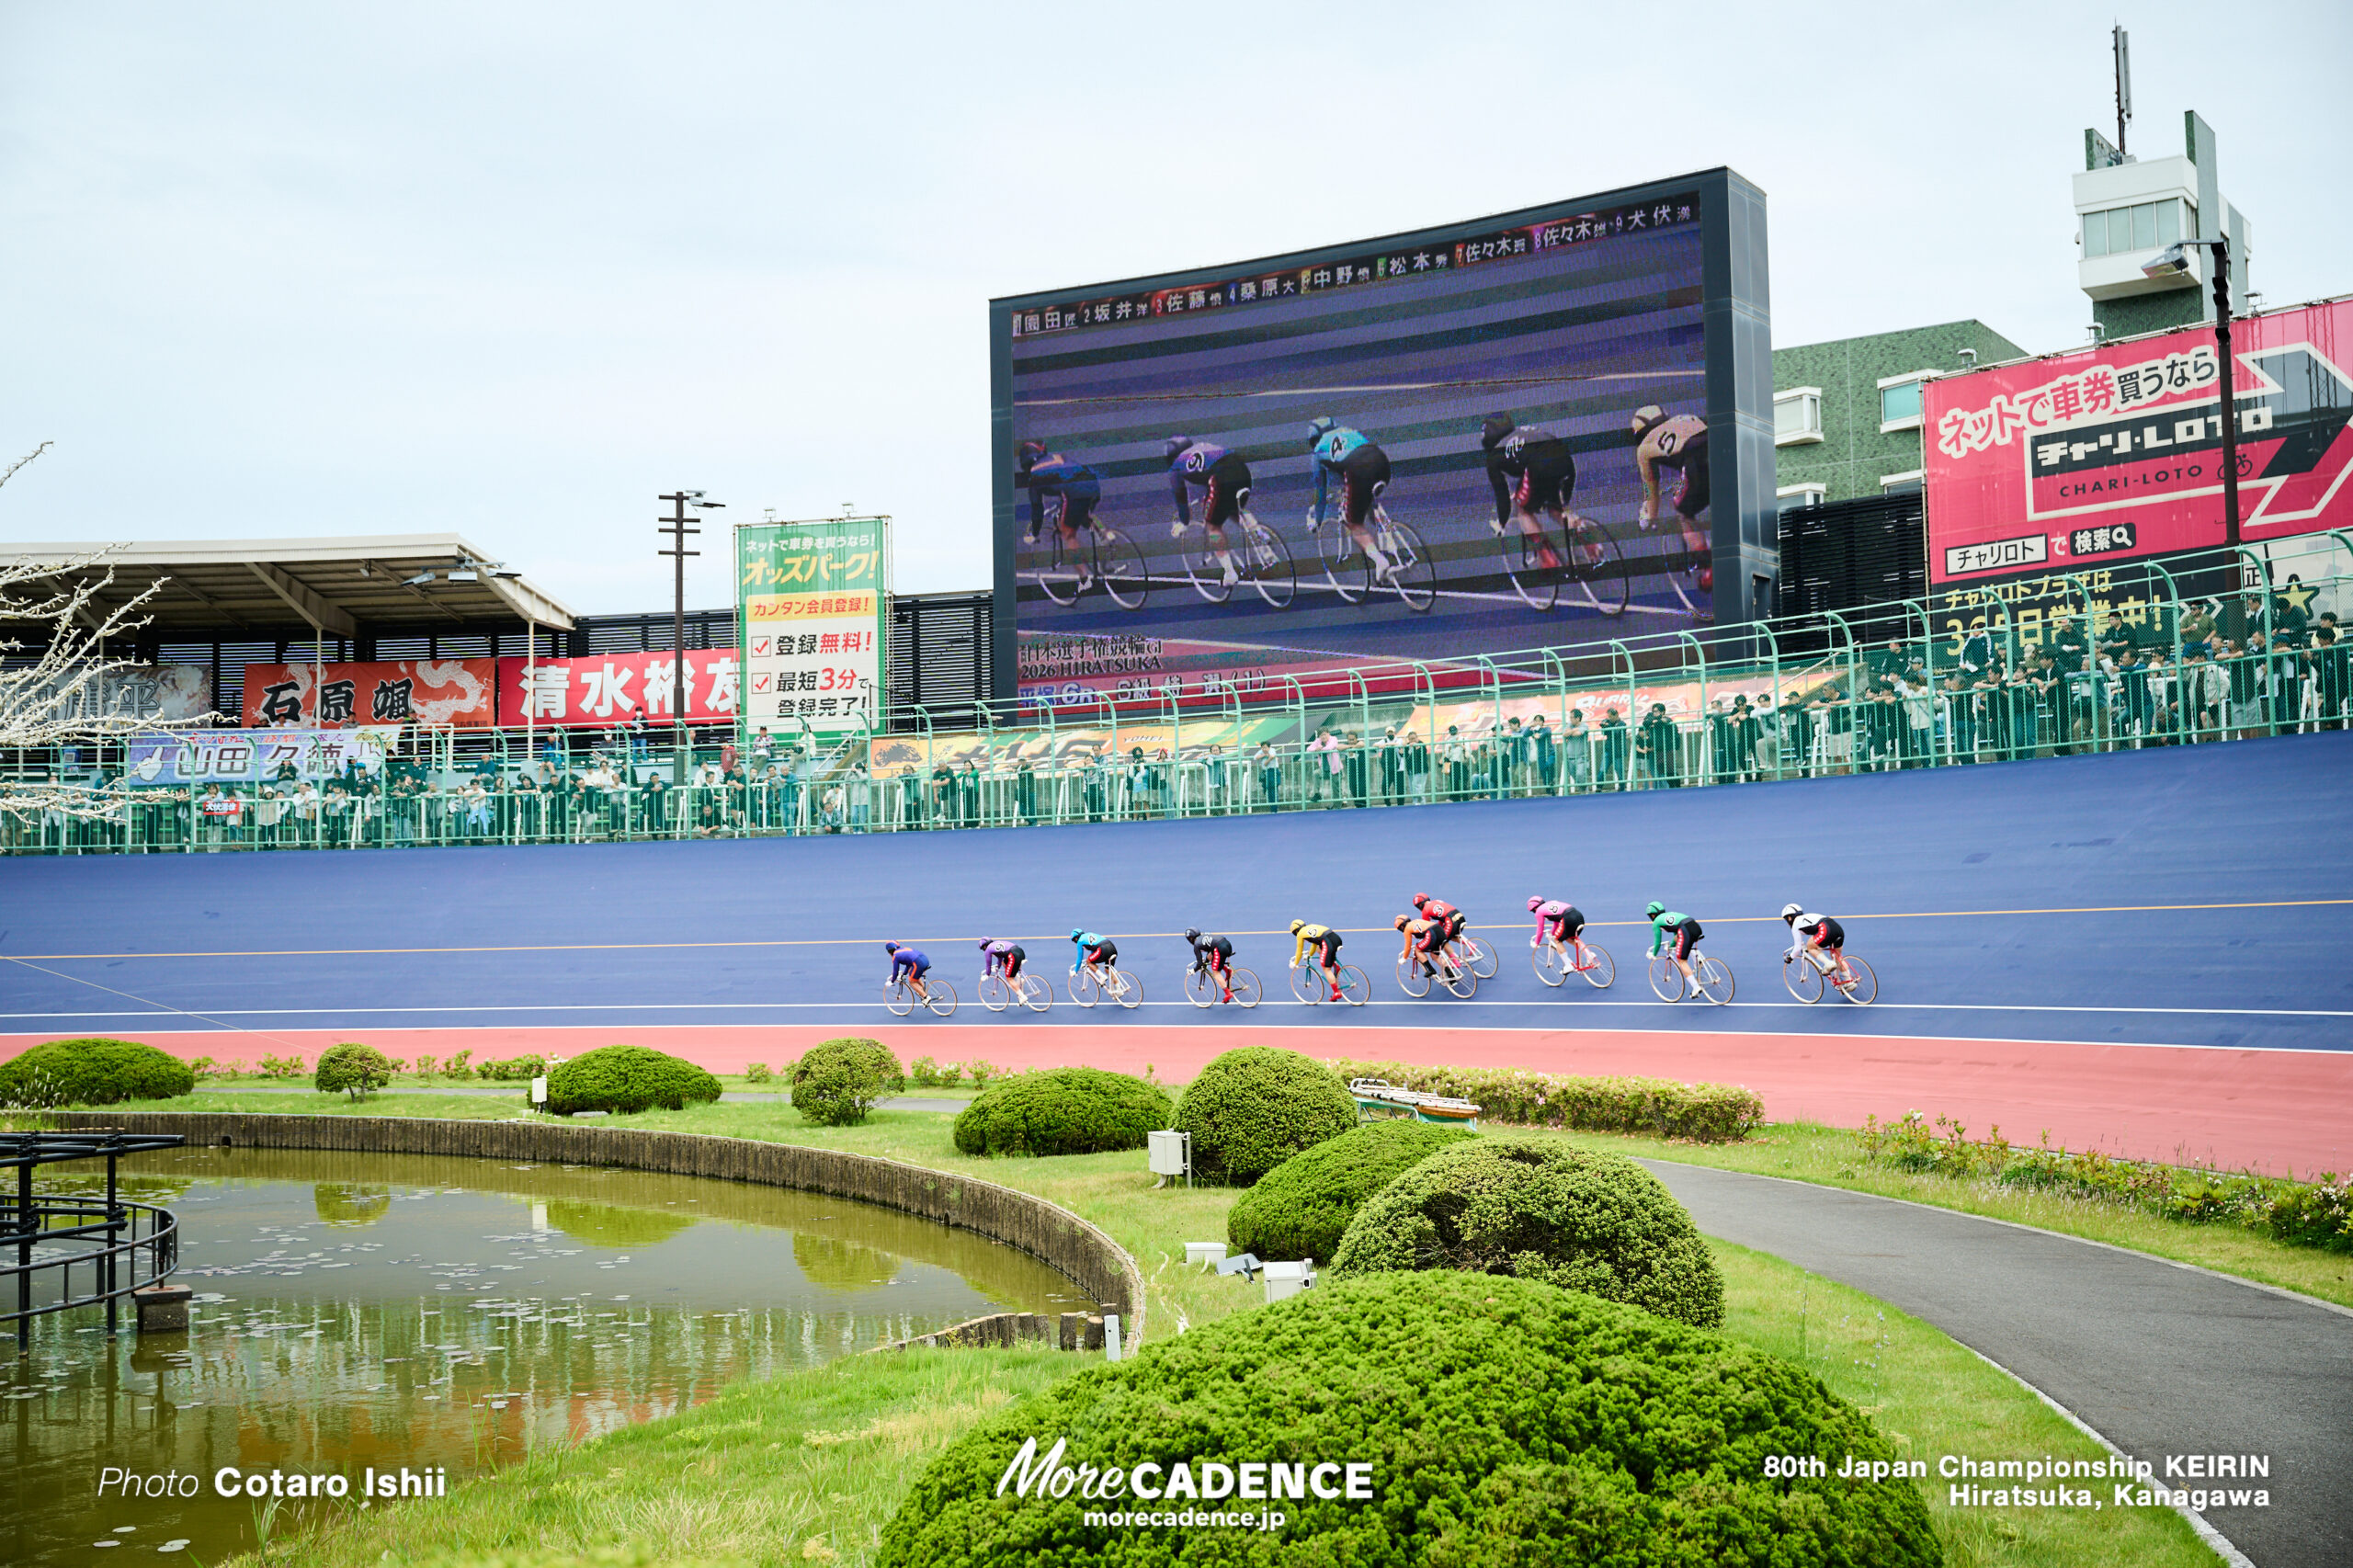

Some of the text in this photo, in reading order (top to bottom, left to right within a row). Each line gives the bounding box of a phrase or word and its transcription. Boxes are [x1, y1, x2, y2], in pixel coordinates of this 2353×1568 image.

[1944, 352, 2216, 453] ネットで車券買うなら
[1657, 430, 1677, 455] 5
[2060, 465, 2202, 497] CHARI-LOTO
[1957, 528, 2112, 570] チャリロト で 検索
[742, 551, 879, 585] オッズパーク!
[754, 597, 869, 617] カンタン会員登録!
[776, 631, 871, 655] 登録無料!
[777, 667, 869, 692] 最短3分で
[1020, 656, 1163, 679] 2026 HIRATSUKA
[262, 677, 414, 723] 石原颯
[518, 657, 740, 719] 清水裕友
[778, 696, 867, 718] 登録完了!
[1433, 904, 1444, 917] 3
[1550, 903, 1560, 915] 8
[1665, 915, 1675, 926] 6
[1201, 934, 1213, 948] 2
[1307, 927, 1318, 938] 5
